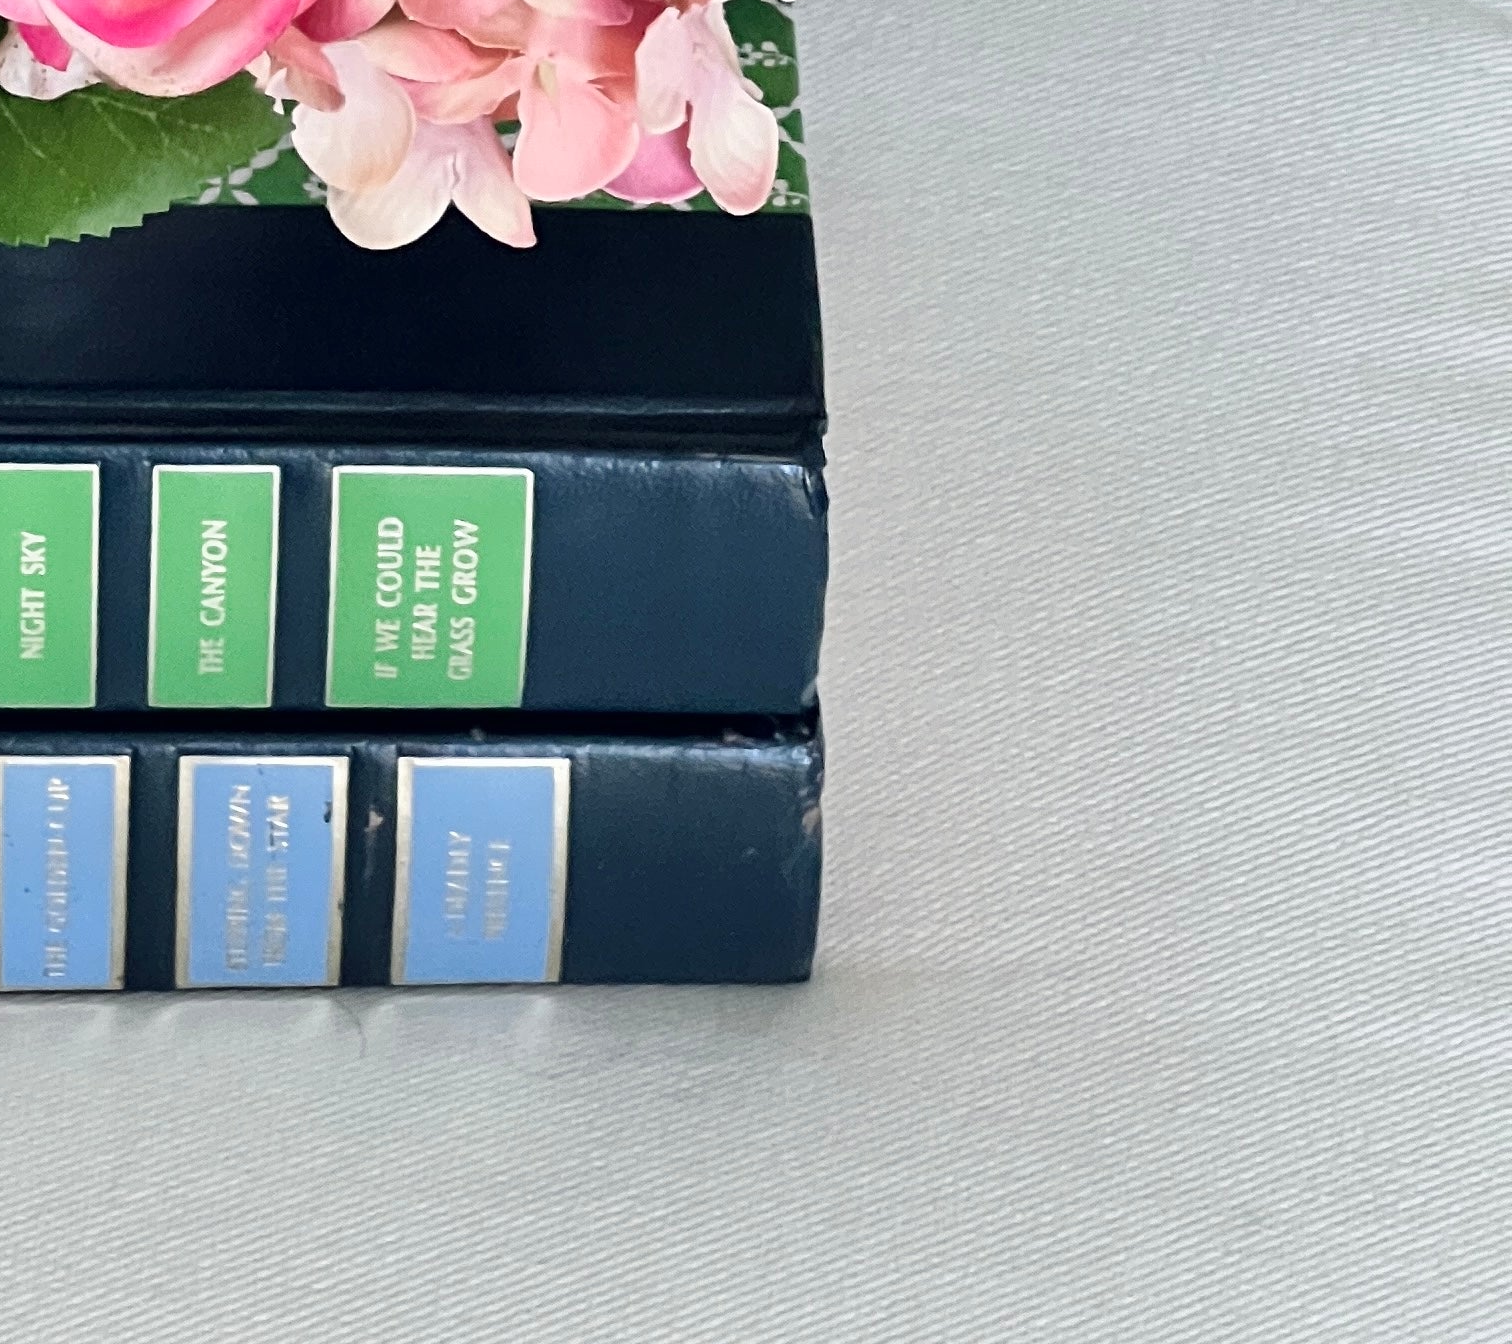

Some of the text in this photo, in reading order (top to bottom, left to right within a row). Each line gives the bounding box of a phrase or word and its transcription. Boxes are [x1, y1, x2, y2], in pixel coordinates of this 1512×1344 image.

[20, 531, 46, 659] NIGHT SKY
[199, 520, 227, 674] THE CANYON
[375, 517, 404, 678] IF WE COULD
[412, 545, 441, 659] HEAR THE
[448, 519, 479, 680] GRASS GROW
[227, 785, 251, 869] DOWN
[266, 795, 290, 852] STAR
